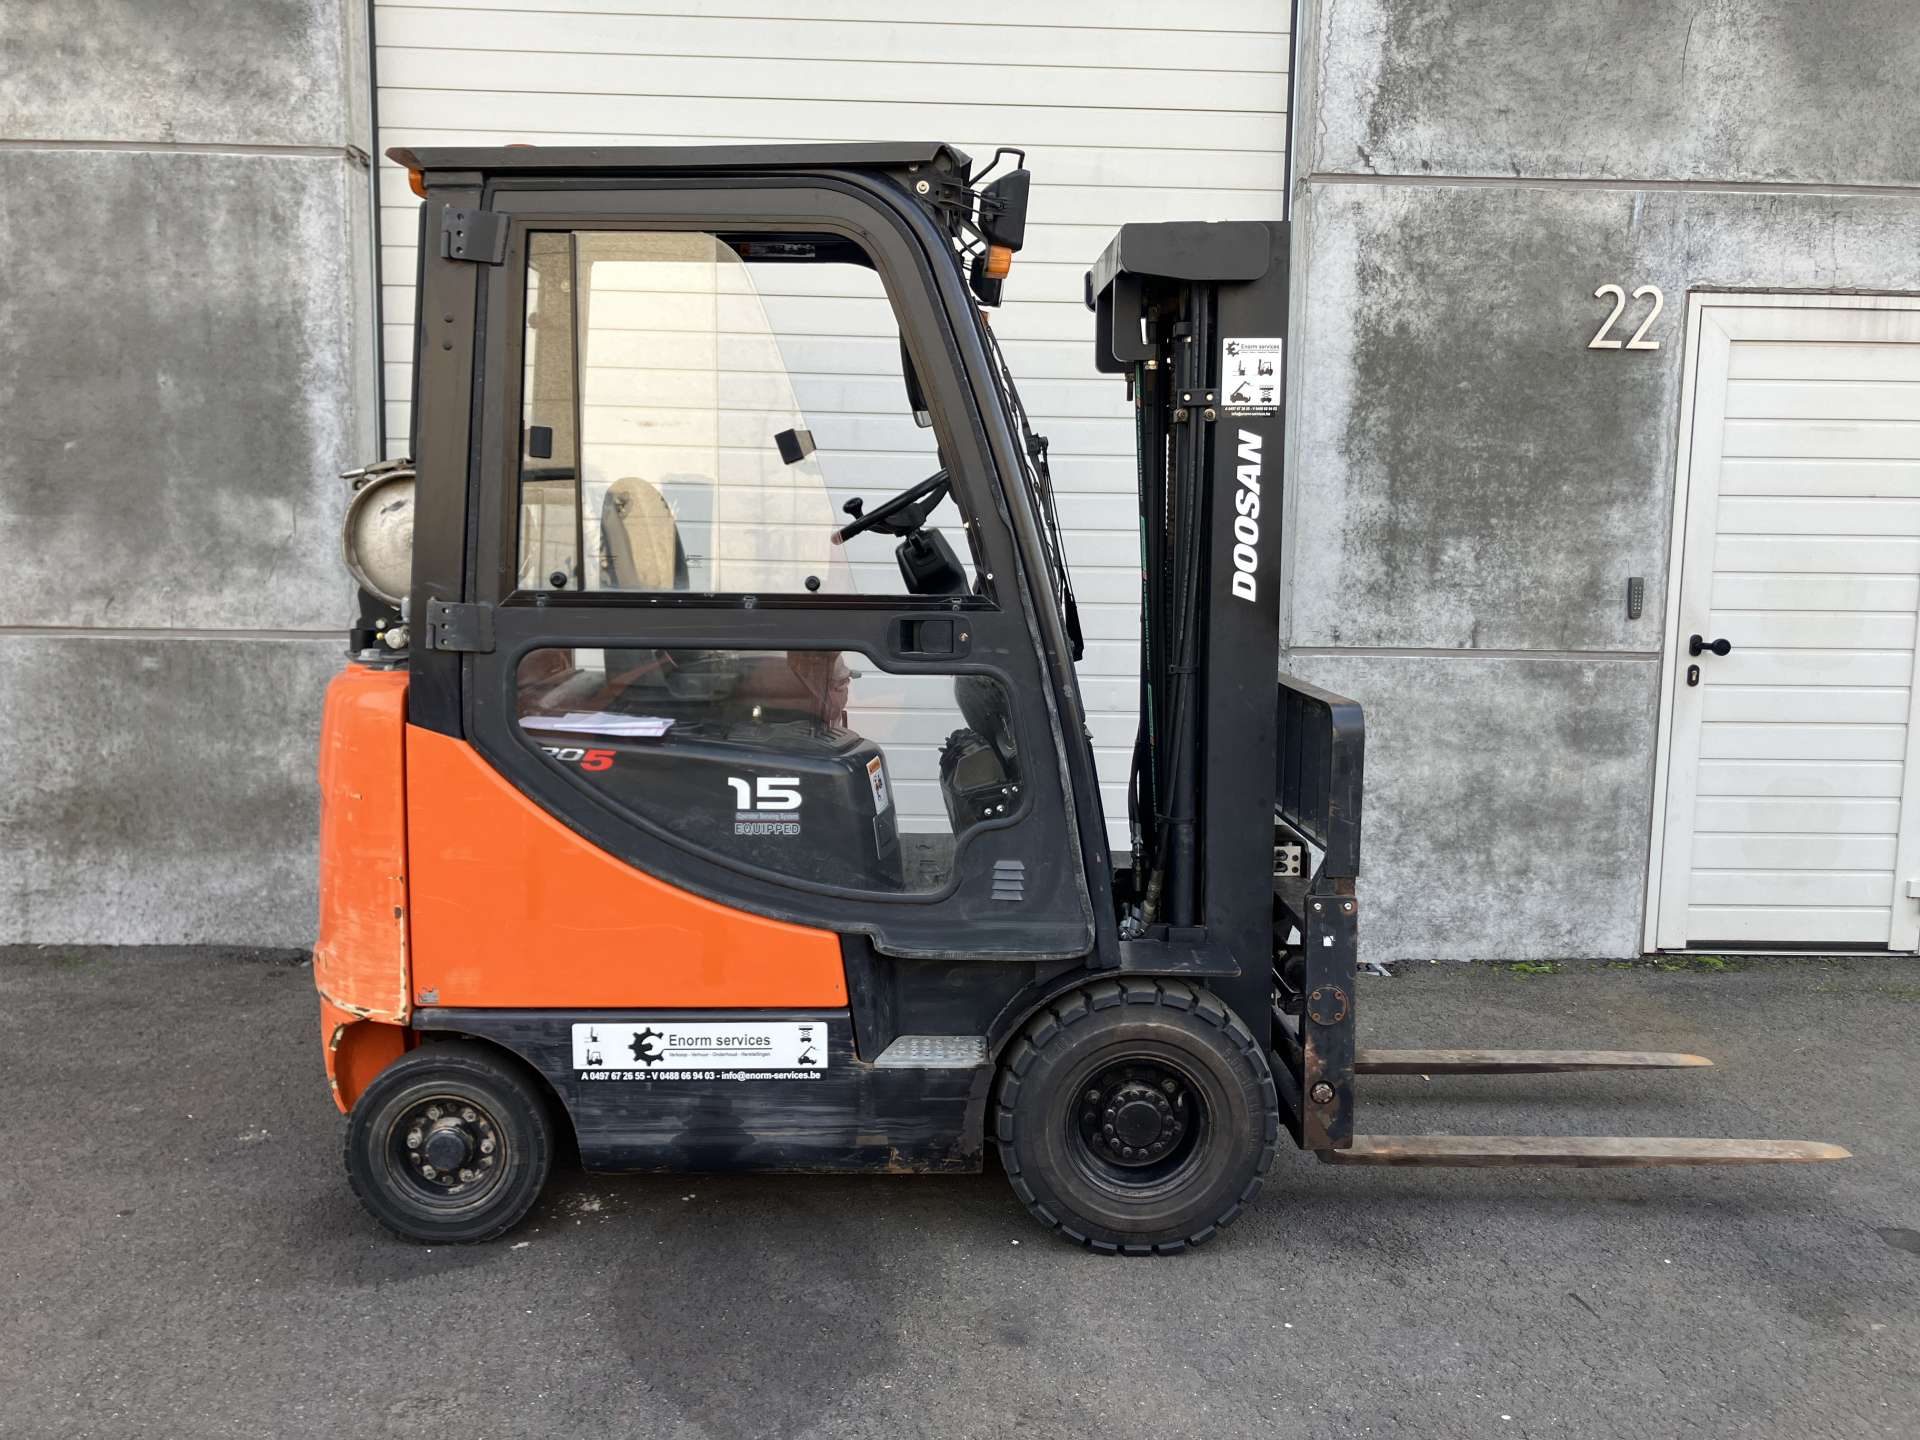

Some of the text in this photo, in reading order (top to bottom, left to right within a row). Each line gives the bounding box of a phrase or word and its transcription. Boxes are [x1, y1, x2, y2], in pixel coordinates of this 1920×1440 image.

[1588, 284, 1664, 350] 22
[1232, 429, 1262, 602] DOOSAN
[727, 776, 802, 810] 15
[734, 822, 801, 836] EQUIPPED
[669, 1033, 771, 1047] Enorm services
[581, 1071, 589, 1080] A
[589, 1071, 610, 1080] 0497
[611, 1071, 621, 1080] 67
[622, 1071, 633, 1080] 26
[634, 1071, 646, 1080] 55
[651, 1071, 658, 1080] V
[660, 1071, 680, 1080] 0488
[680, 1071, 692, 1080] 66
[692, 1071, 703, 1080] 94
[704, 1071, 715, 1080] 03
[721, 1070, 821, 1081] info@enorm-services.be
